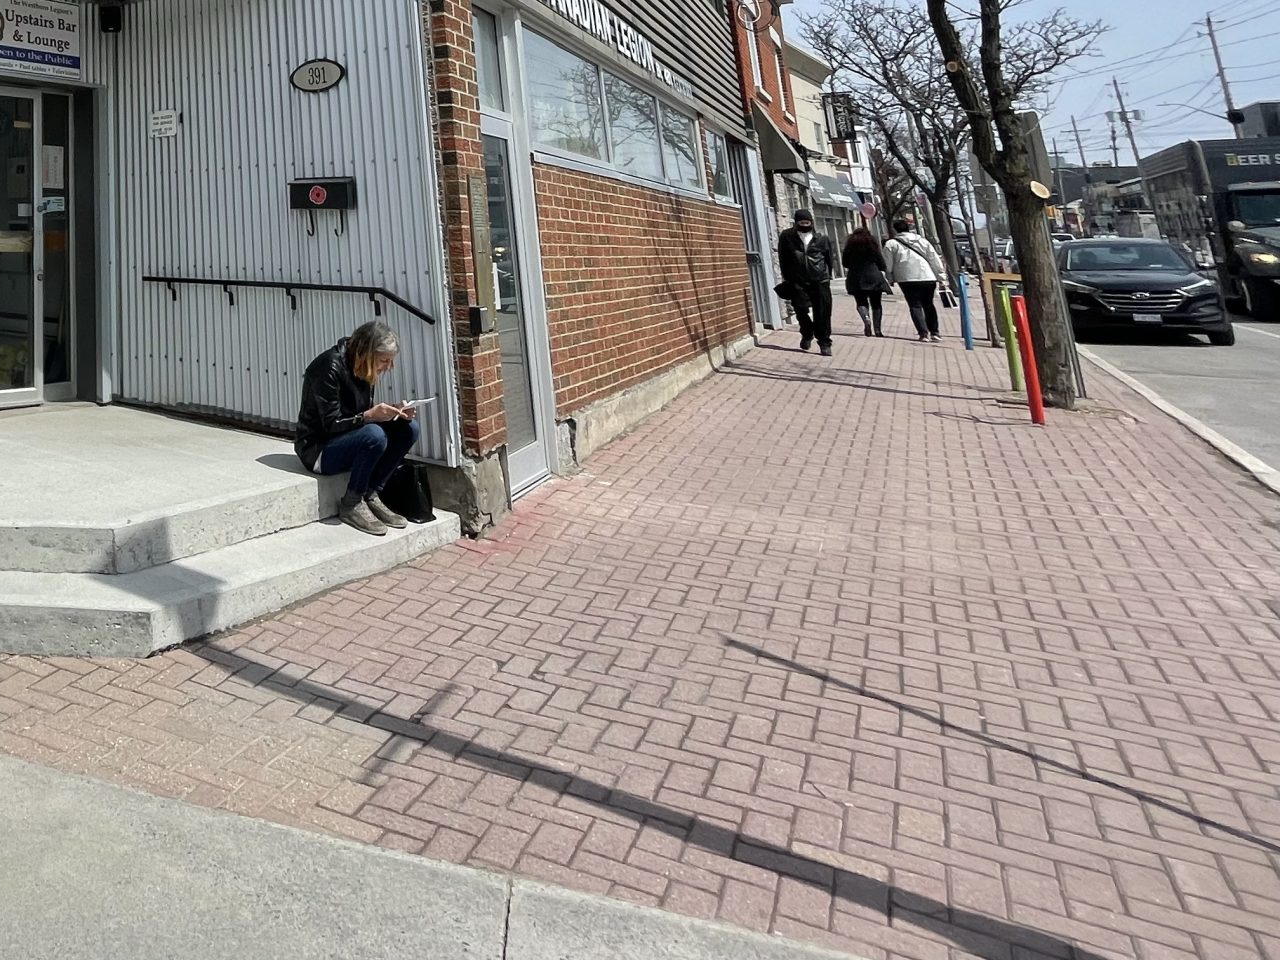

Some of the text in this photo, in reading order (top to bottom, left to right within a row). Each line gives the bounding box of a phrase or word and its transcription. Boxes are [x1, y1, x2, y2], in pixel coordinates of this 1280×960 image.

[4, 8, 77, 32] Upstairs Bar
[13, 29, 70, 52] & Lounge
[613, 15, 655, 73] LEGION
[16, 49, 25, 58] to
[27, 51, 43, 61] the
[45, 53, 73, 65] Public
[308, 66, 328, 86] 391
[1224, 153, 1271, 166] BEER
